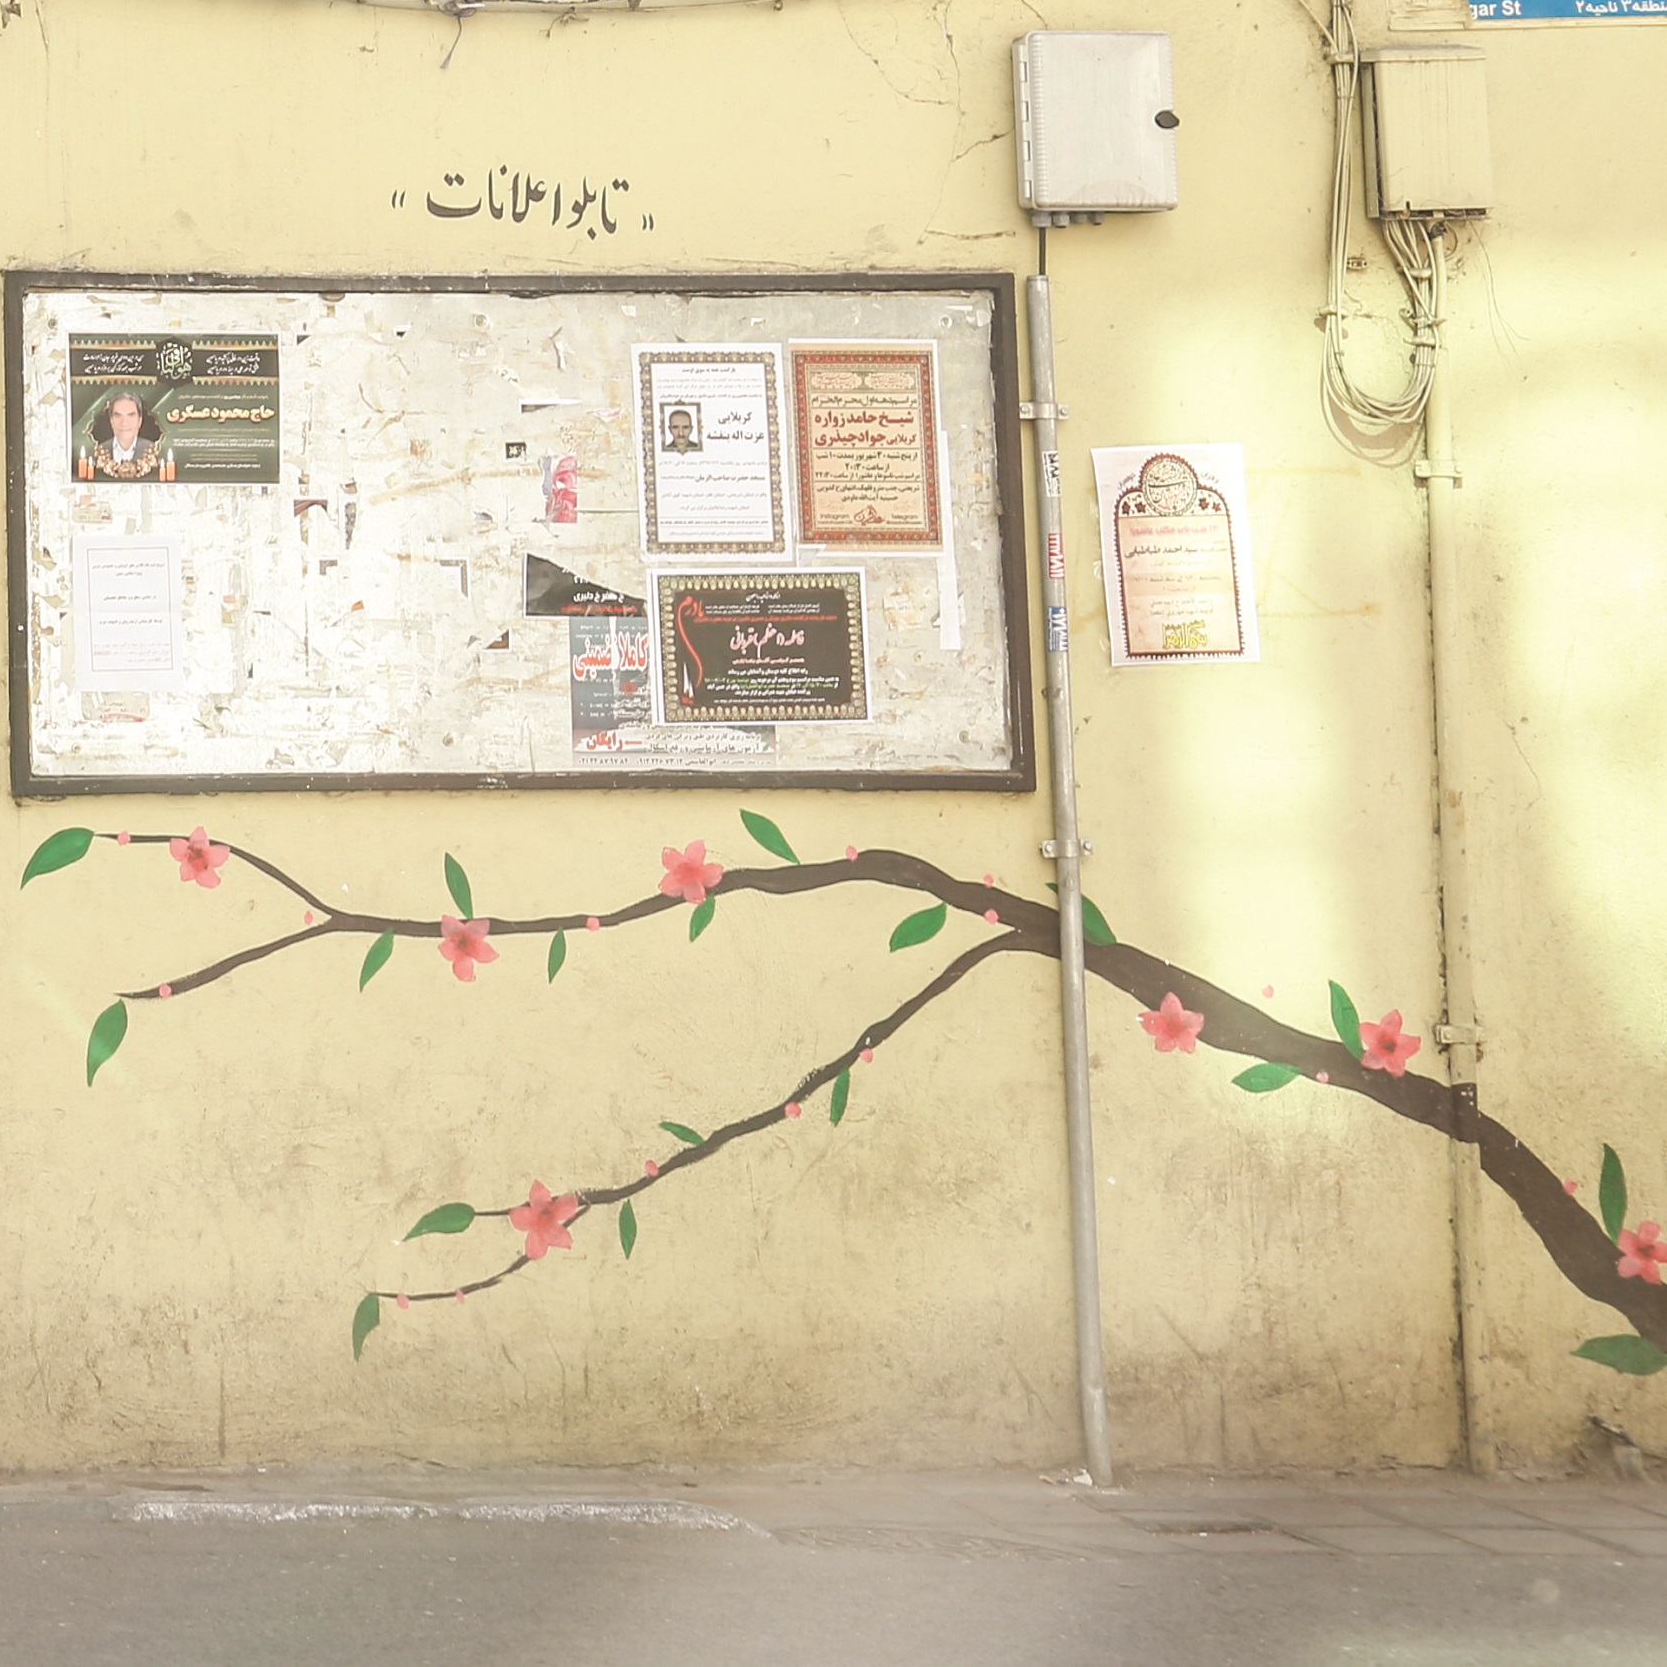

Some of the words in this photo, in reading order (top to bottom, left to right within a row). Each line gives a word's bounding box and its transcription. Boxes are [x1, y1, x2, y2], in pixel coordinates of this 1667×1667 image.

[1470, 1, 1497, 19] gar
[1501, 0, 1521, 16] St
[847, 411, 877, 423] حامد
[878, 411, 914, 427] شیخ
